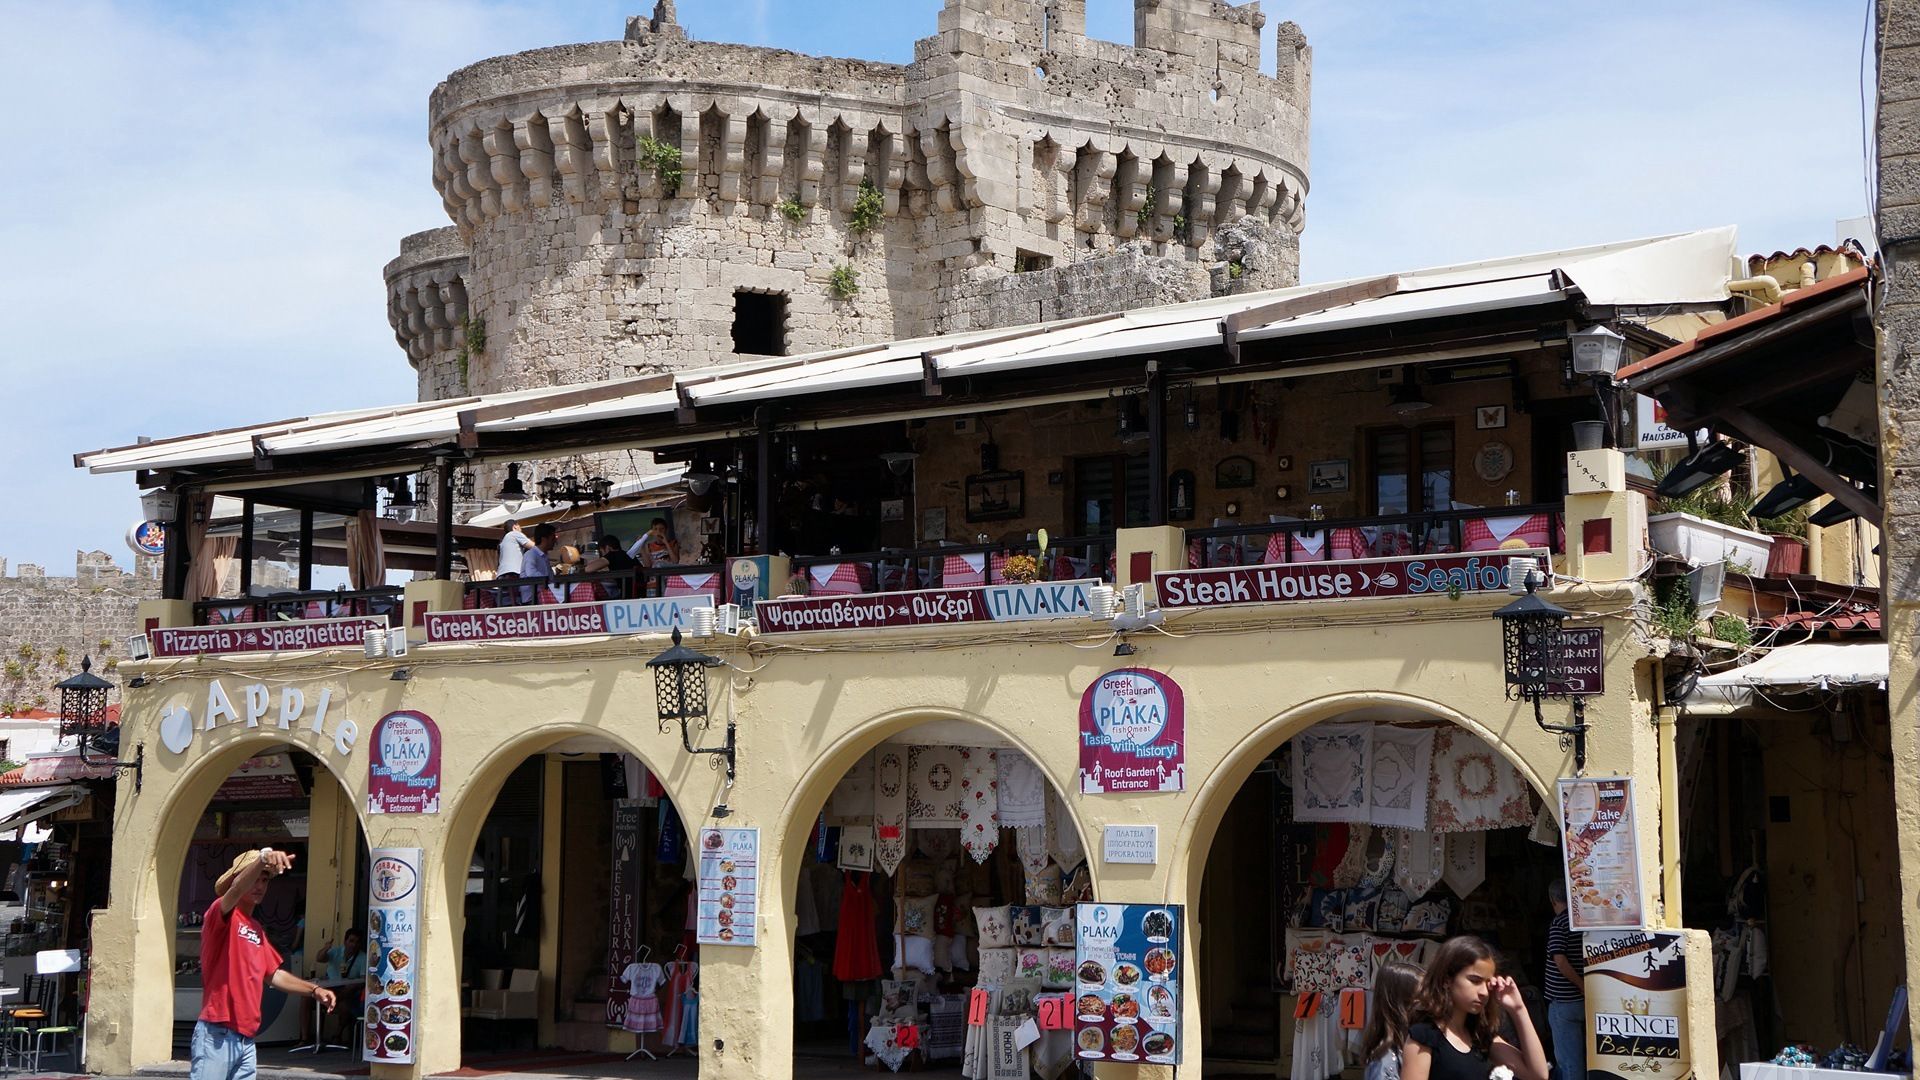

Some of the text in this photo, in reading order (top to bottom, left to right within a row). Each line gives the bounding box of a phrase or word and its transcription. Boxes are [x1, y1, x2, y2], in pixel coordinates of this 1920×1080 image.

[1569, 453, 1608, 489] PLAKA
[1166, 556, 1542, 606] Steak House Seafo
[767, 585, 1090, 628] Ψαροταβέρνα Ουζερί ΠΛΑΚΑ
[431, 602, 684, 639] Greek Steak House PLAKA
[163, 630, 231, 652] Pizzeria
[1103, 678, 1133, 690] Greek
[1112, 686, 1156, 697] restaurant
[205, 679, 359, 756] Apple
[387, 720, 408, 730] Greek
[1100, 704, 1162, 727] PLAKA
[384, 743, 427, 760] PLAKA
[1082, 732, 1178, 760] Taste with history!
[371, 764, 437, 789] Taste with history!
[1104, 767, 1156, 779] Roof Garden
[1111, 779, 1149, 789] Entrance
[385, 795, 421, 803] Roof Garden
[389, 804, 416, 813] Entrance
[615, 810, 638, 823] Free
[1596, 809, 1620, 820] Take
[1116, 830, 1145, 838] ΠΛΑΤΕΙΑ
[1589, 821, 1615, 832] away
[732, 842, 753, 851] PLAKA
[386, 923, 413, 933] PLAKA
[610, 859, 622, 988] RESTAURANT
[623, 894, 632, 950] PLAKA
[1082, 925, 1118, 938] PLAKA
[1585, 932, 1648, 958] Roof Garden
[1586, 943, 1651, 966] Bistro Entrance
[974, 993, 980, 1022] 1
[1042, 1001, 1054, 1027] 2
[1597, 1012, 1677, 1037] PRINCE
[1003, 1031, 1013, 1065] RHODES
[1599, 1035, 1680, 1060] Bakery
